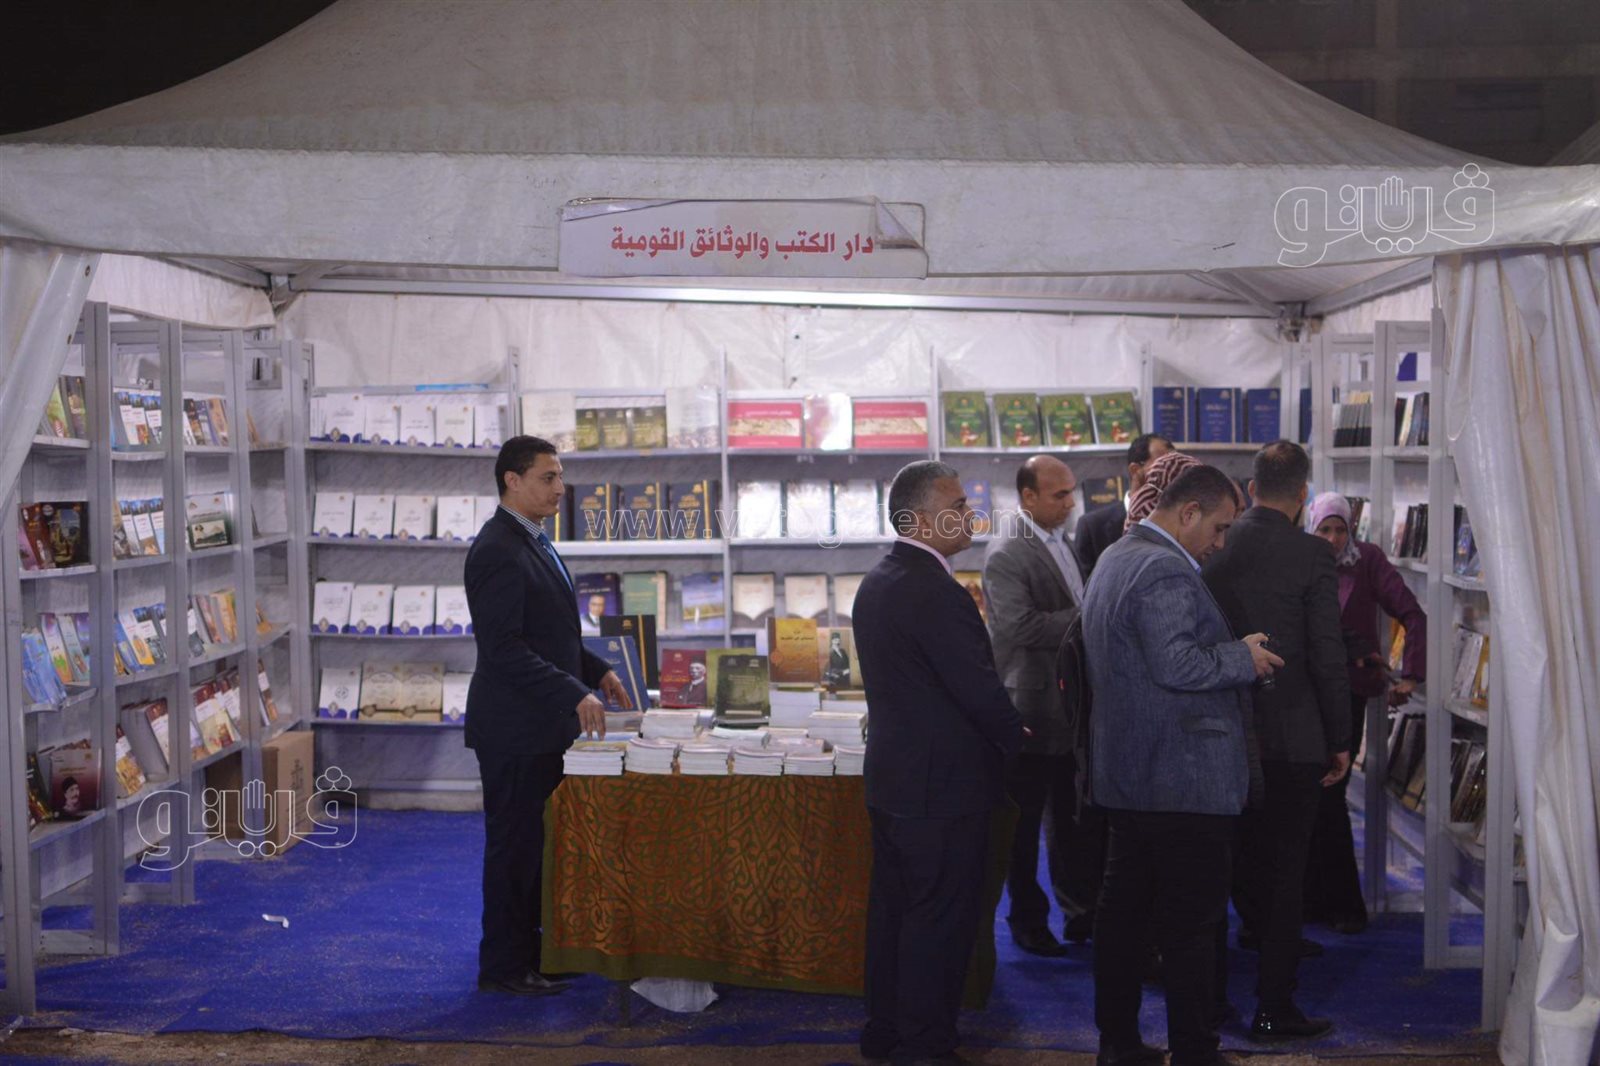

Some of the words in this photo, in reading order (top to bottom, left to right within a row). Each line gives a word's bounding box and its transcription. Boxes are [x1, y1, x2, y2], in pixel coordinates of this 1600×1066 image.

[610, 226, 685, 258] القومية
[690, 225, 770, 260] والوثائق
[774, 231, 835, 260] الكتب
[843, 232, 875, 262] دار
